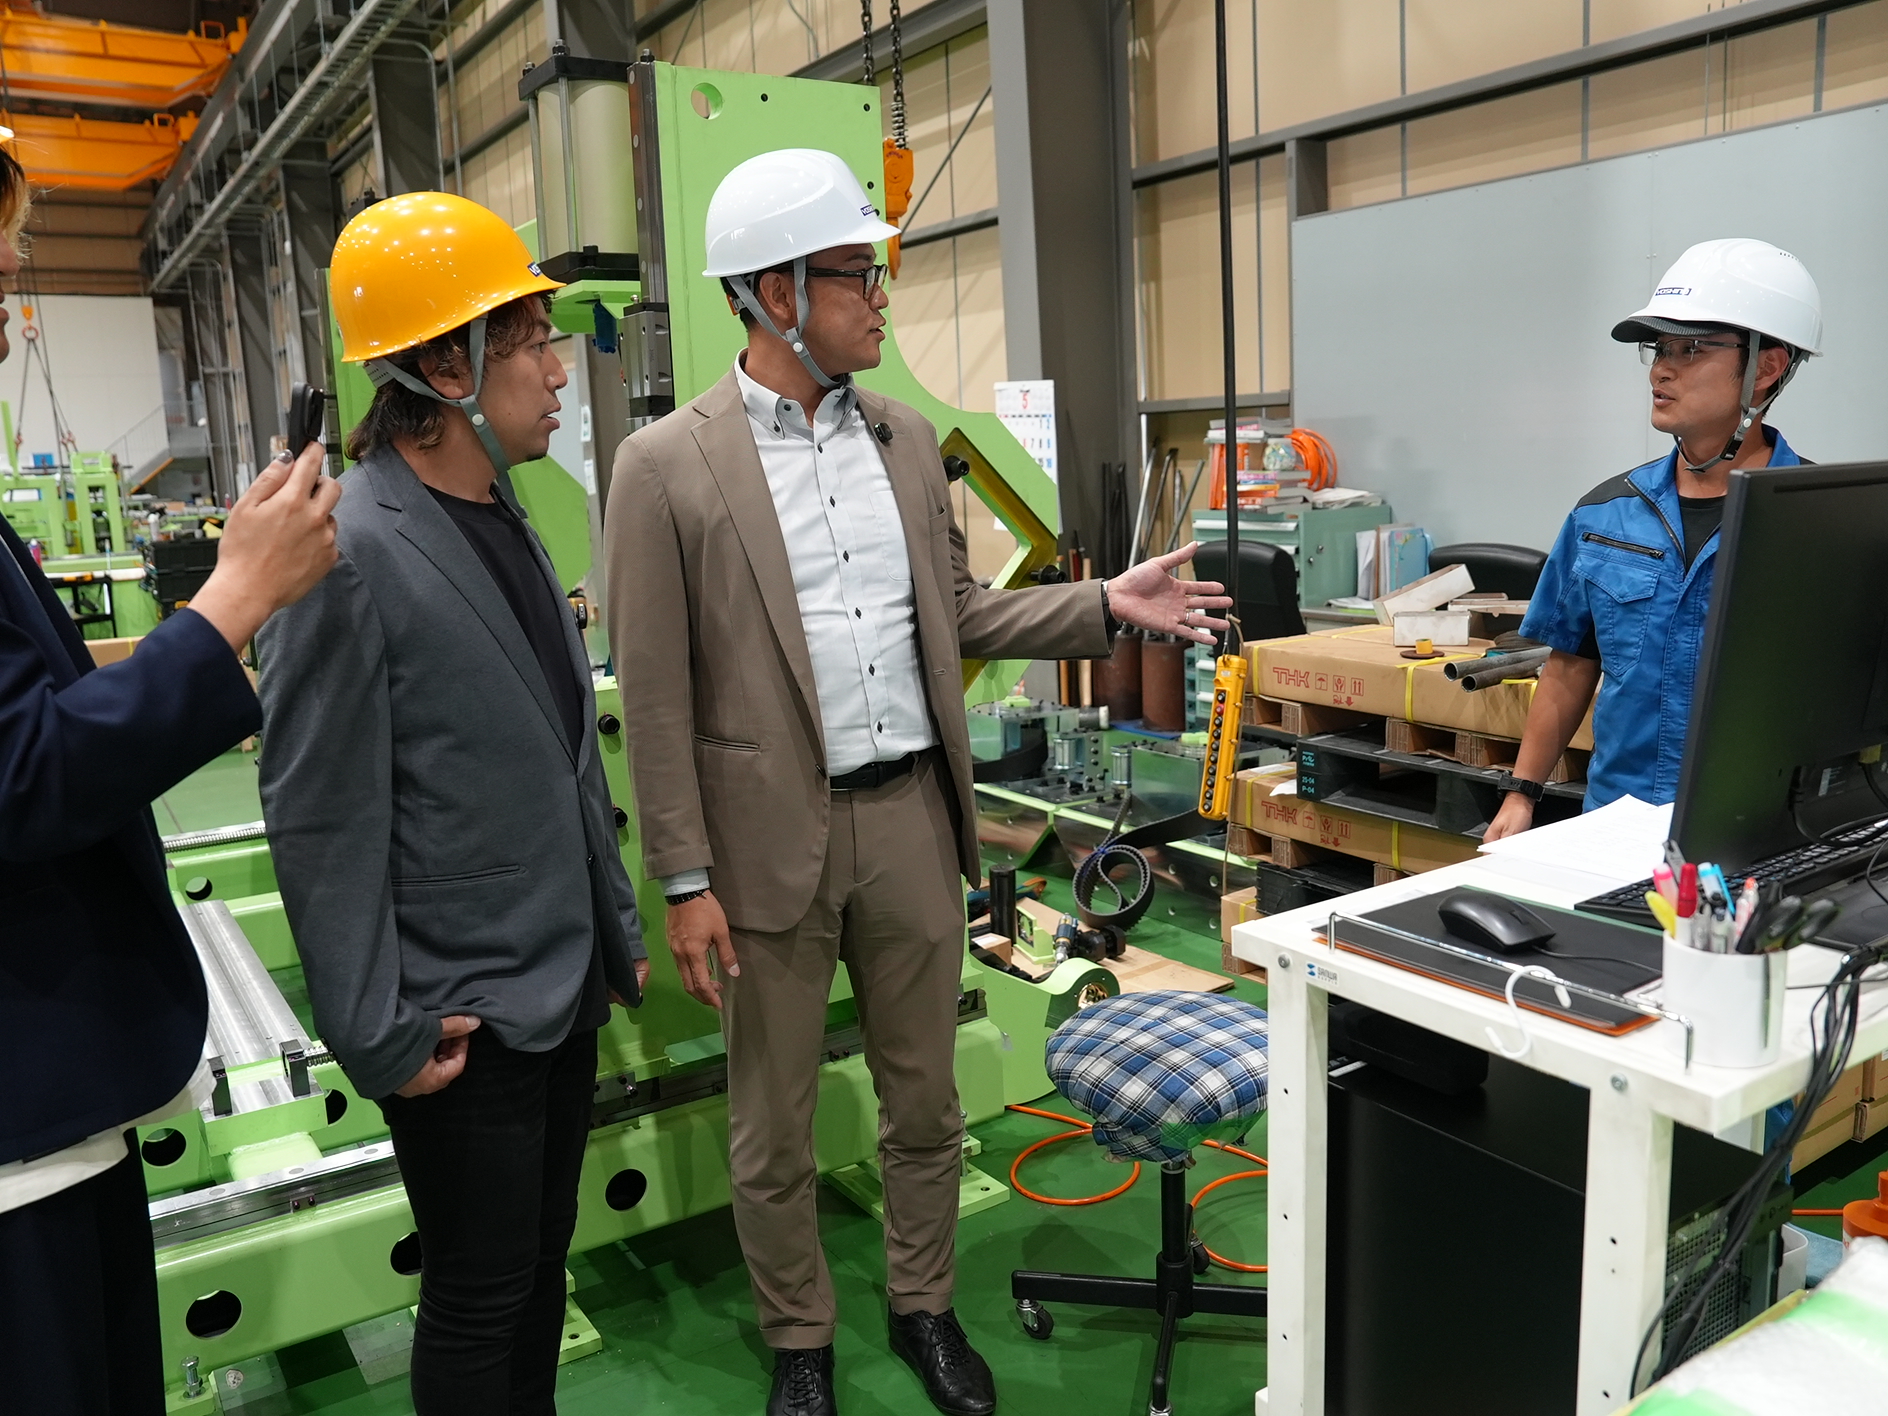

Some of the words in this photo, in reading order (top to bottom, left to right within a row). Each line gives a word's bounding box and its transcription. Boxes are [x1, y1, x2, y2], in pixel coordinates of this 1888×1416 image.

[1021, 393, 1028, 409] 5
[1273, 667, 1310, 689] THK
[1262, 801, 1297, 825] THK
